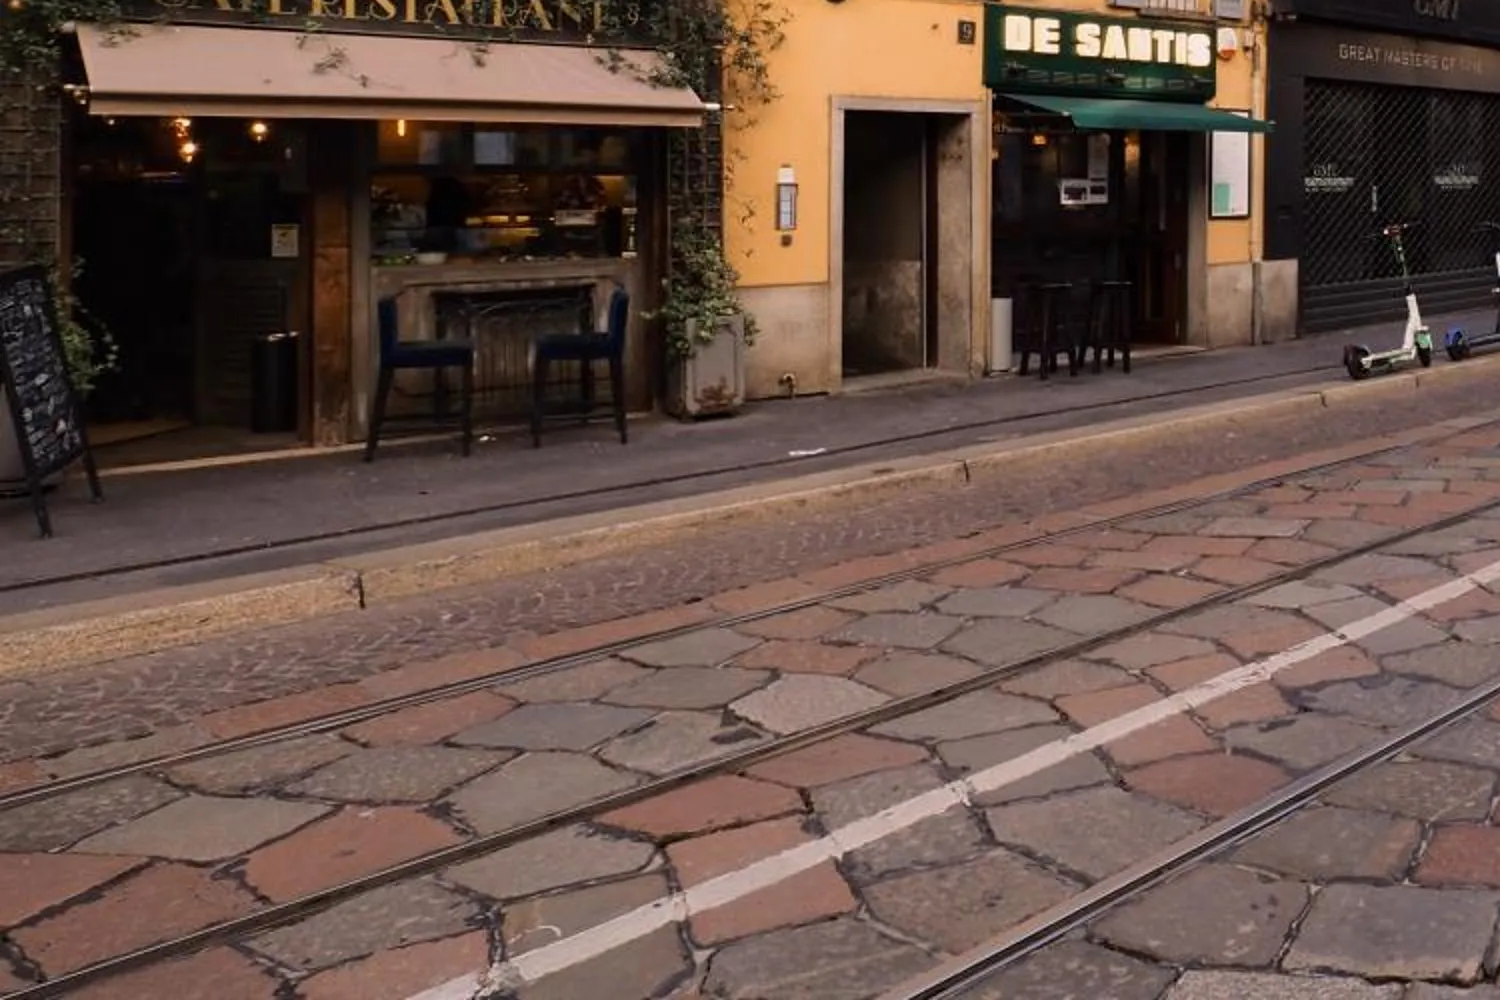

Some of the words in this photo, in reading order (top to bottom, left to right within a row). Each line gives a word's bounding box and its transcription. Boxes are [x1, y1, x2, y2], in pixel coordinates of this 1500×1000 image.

[1004, 14, 1061, 55] DE
[1075, 22, 1211, 67] SANTIS
[1339, 43, 1380, 63] GREAT
